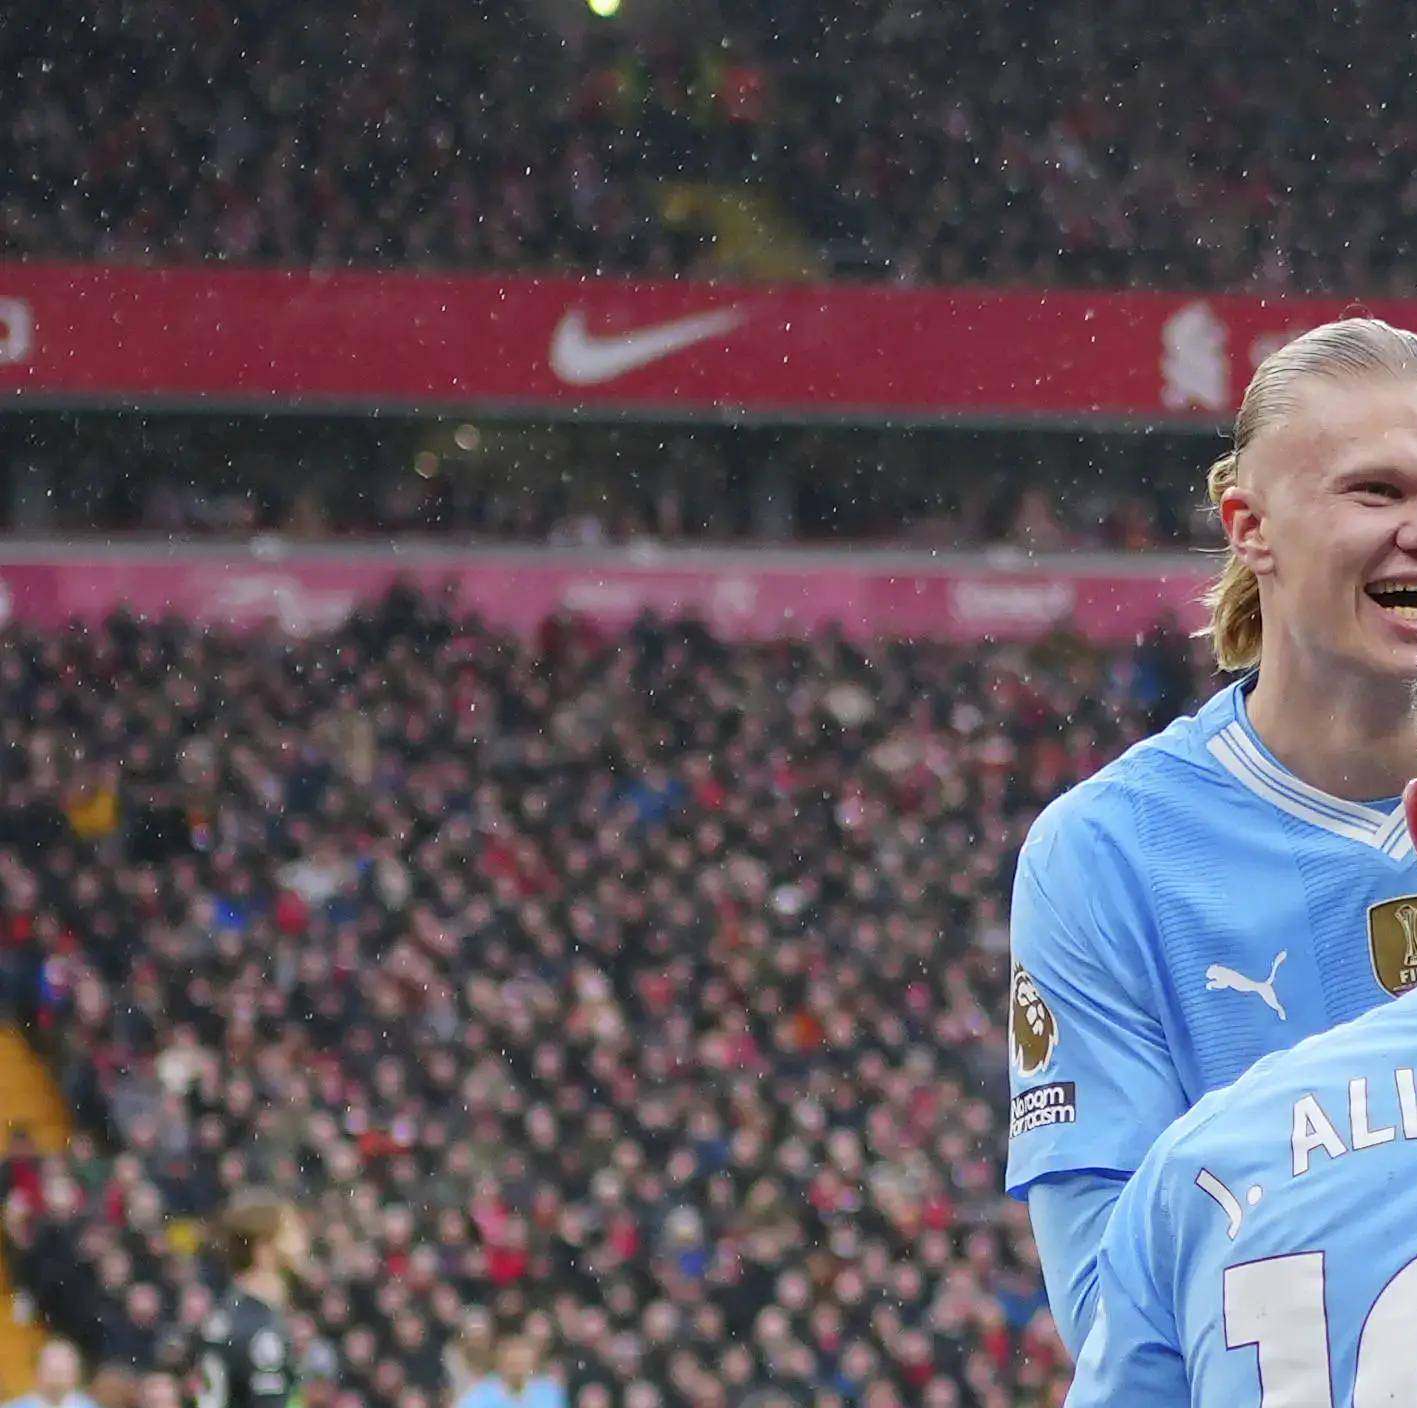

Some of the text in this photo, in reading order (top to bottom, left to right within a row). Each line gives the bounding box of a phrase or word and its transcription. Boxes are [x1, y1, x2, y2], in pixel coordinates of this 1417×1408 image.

[1024, 1086, 1065, 1112] room
[1024, 1104, 1075, 1132] racism
[1195, 1168, 1263, 1240] J.
